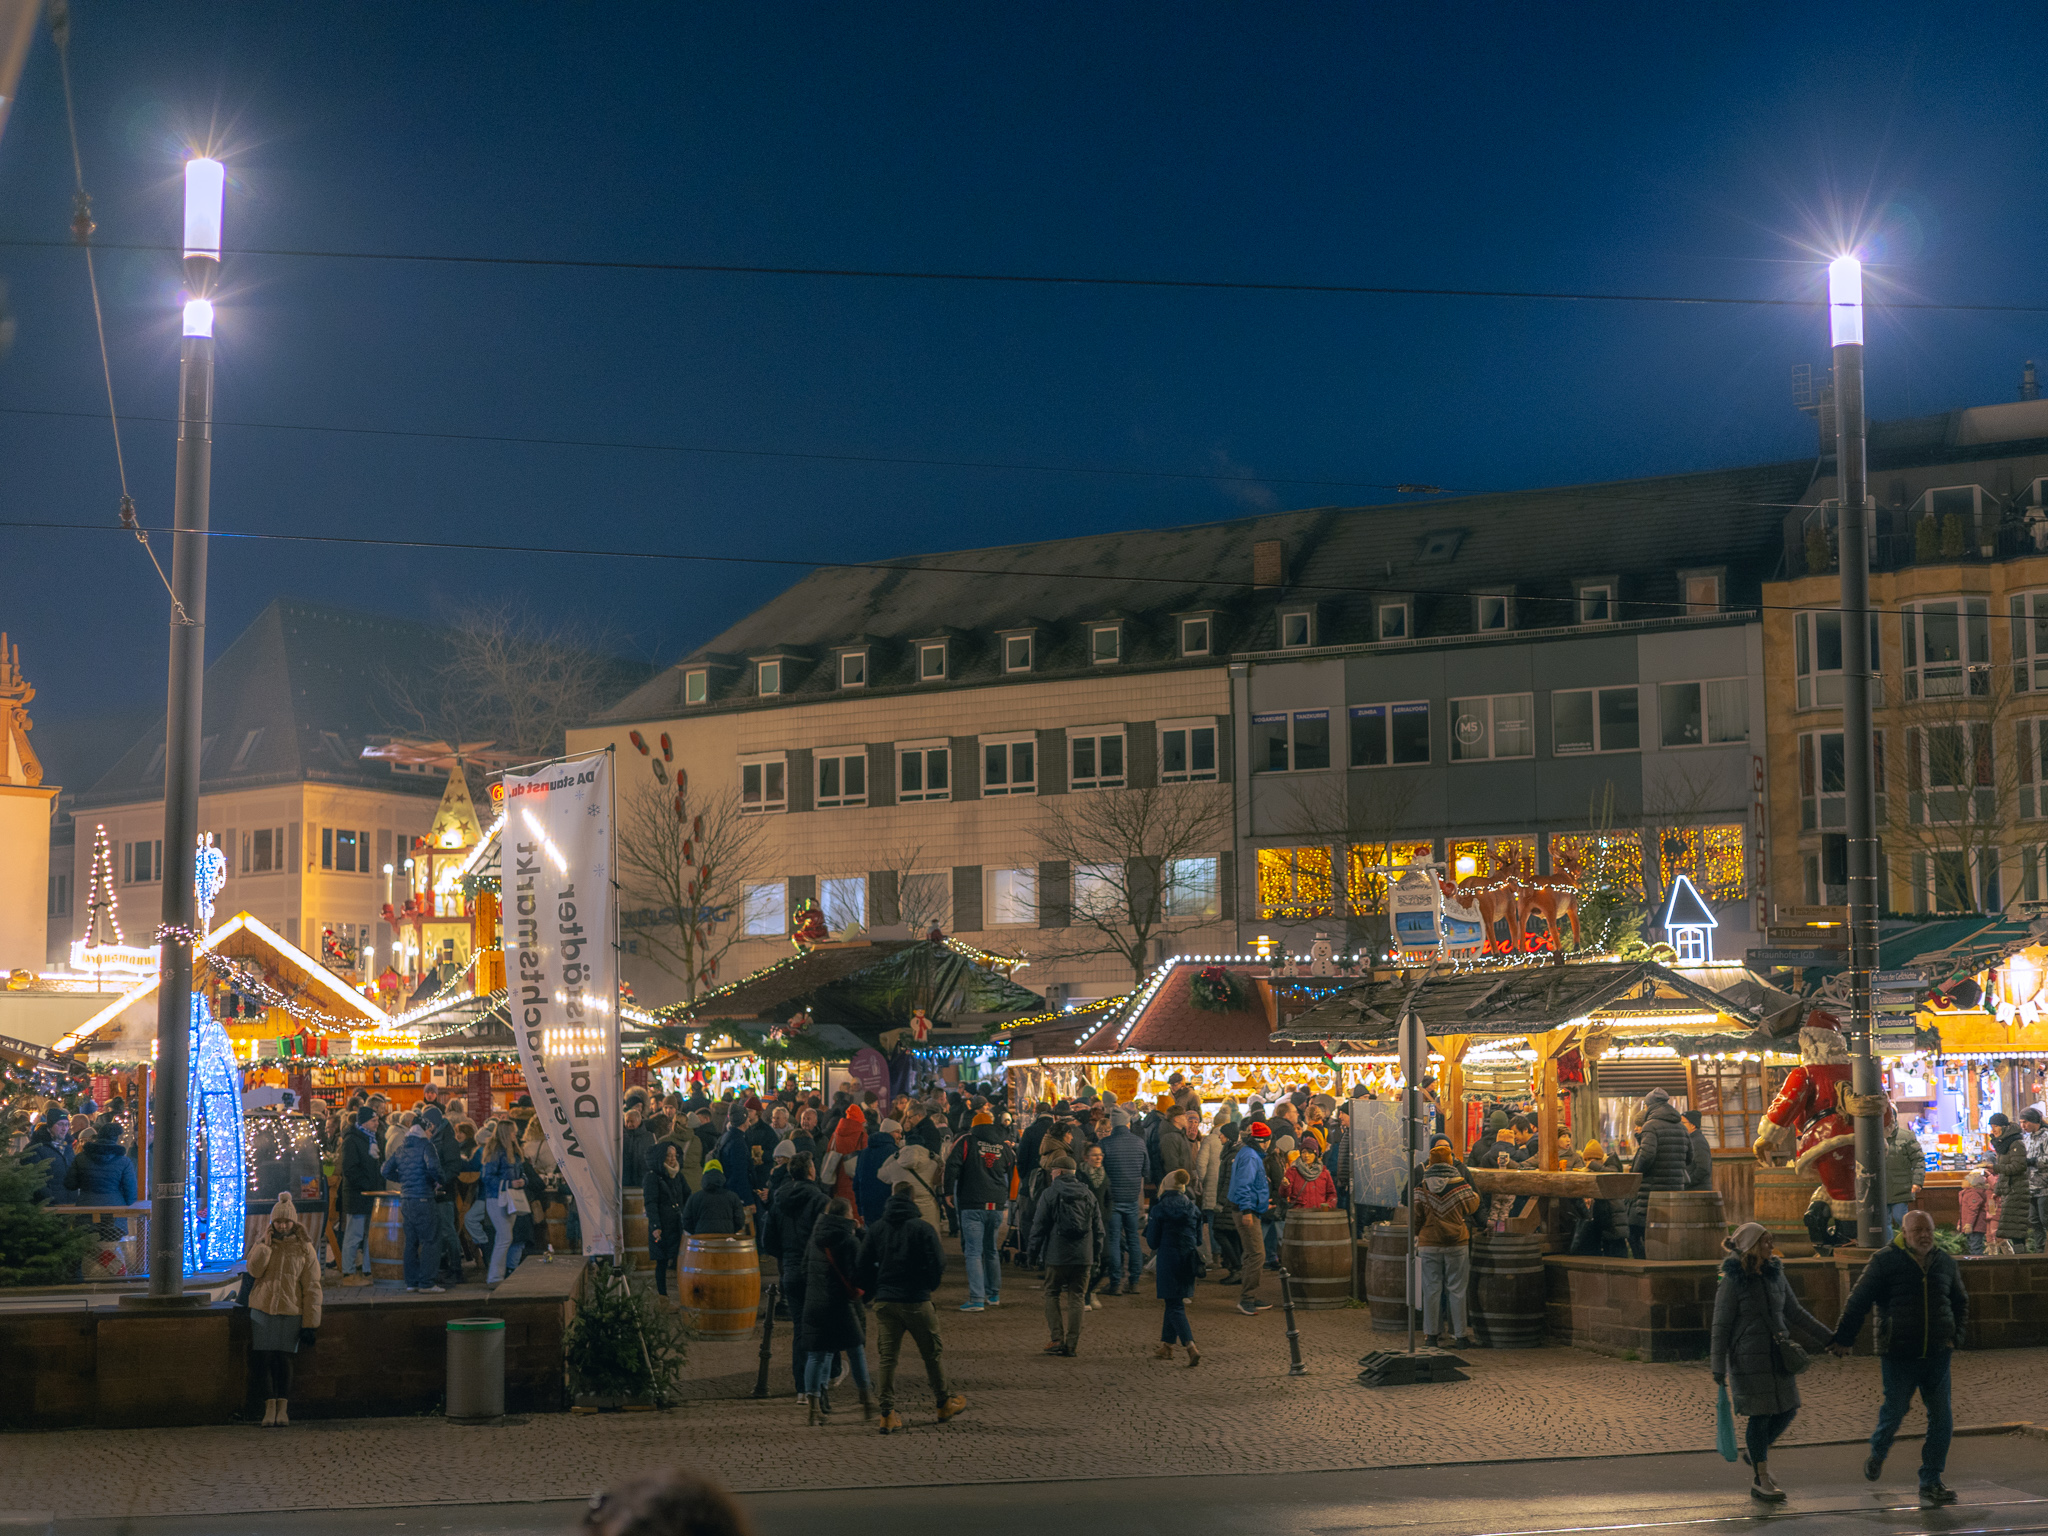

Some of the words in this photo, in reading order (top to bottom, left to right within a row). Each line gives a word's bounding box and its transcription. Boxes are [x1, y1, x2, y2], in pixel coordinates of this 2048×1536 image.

[1357, 708, 1377, 716] ZUMBA
[1393, 705, 1428, 713] AERIALYOGA
[1254, 715, 1286, 723] YOGAKURSE
[1296, 712, 1328, 720] TANZKURSE
[1460, 722, 1478, 732] M5
[1791, 929, 1831, 938] Darmstadt
[1757, 950, 1799, 959] Fraunhofer
[1801, 951, 1815, 959] IGD
[1878, 995, 1910, 1004] Schlossmuseum
[1878, 1018, 1909, 1027] Landesmuseum
